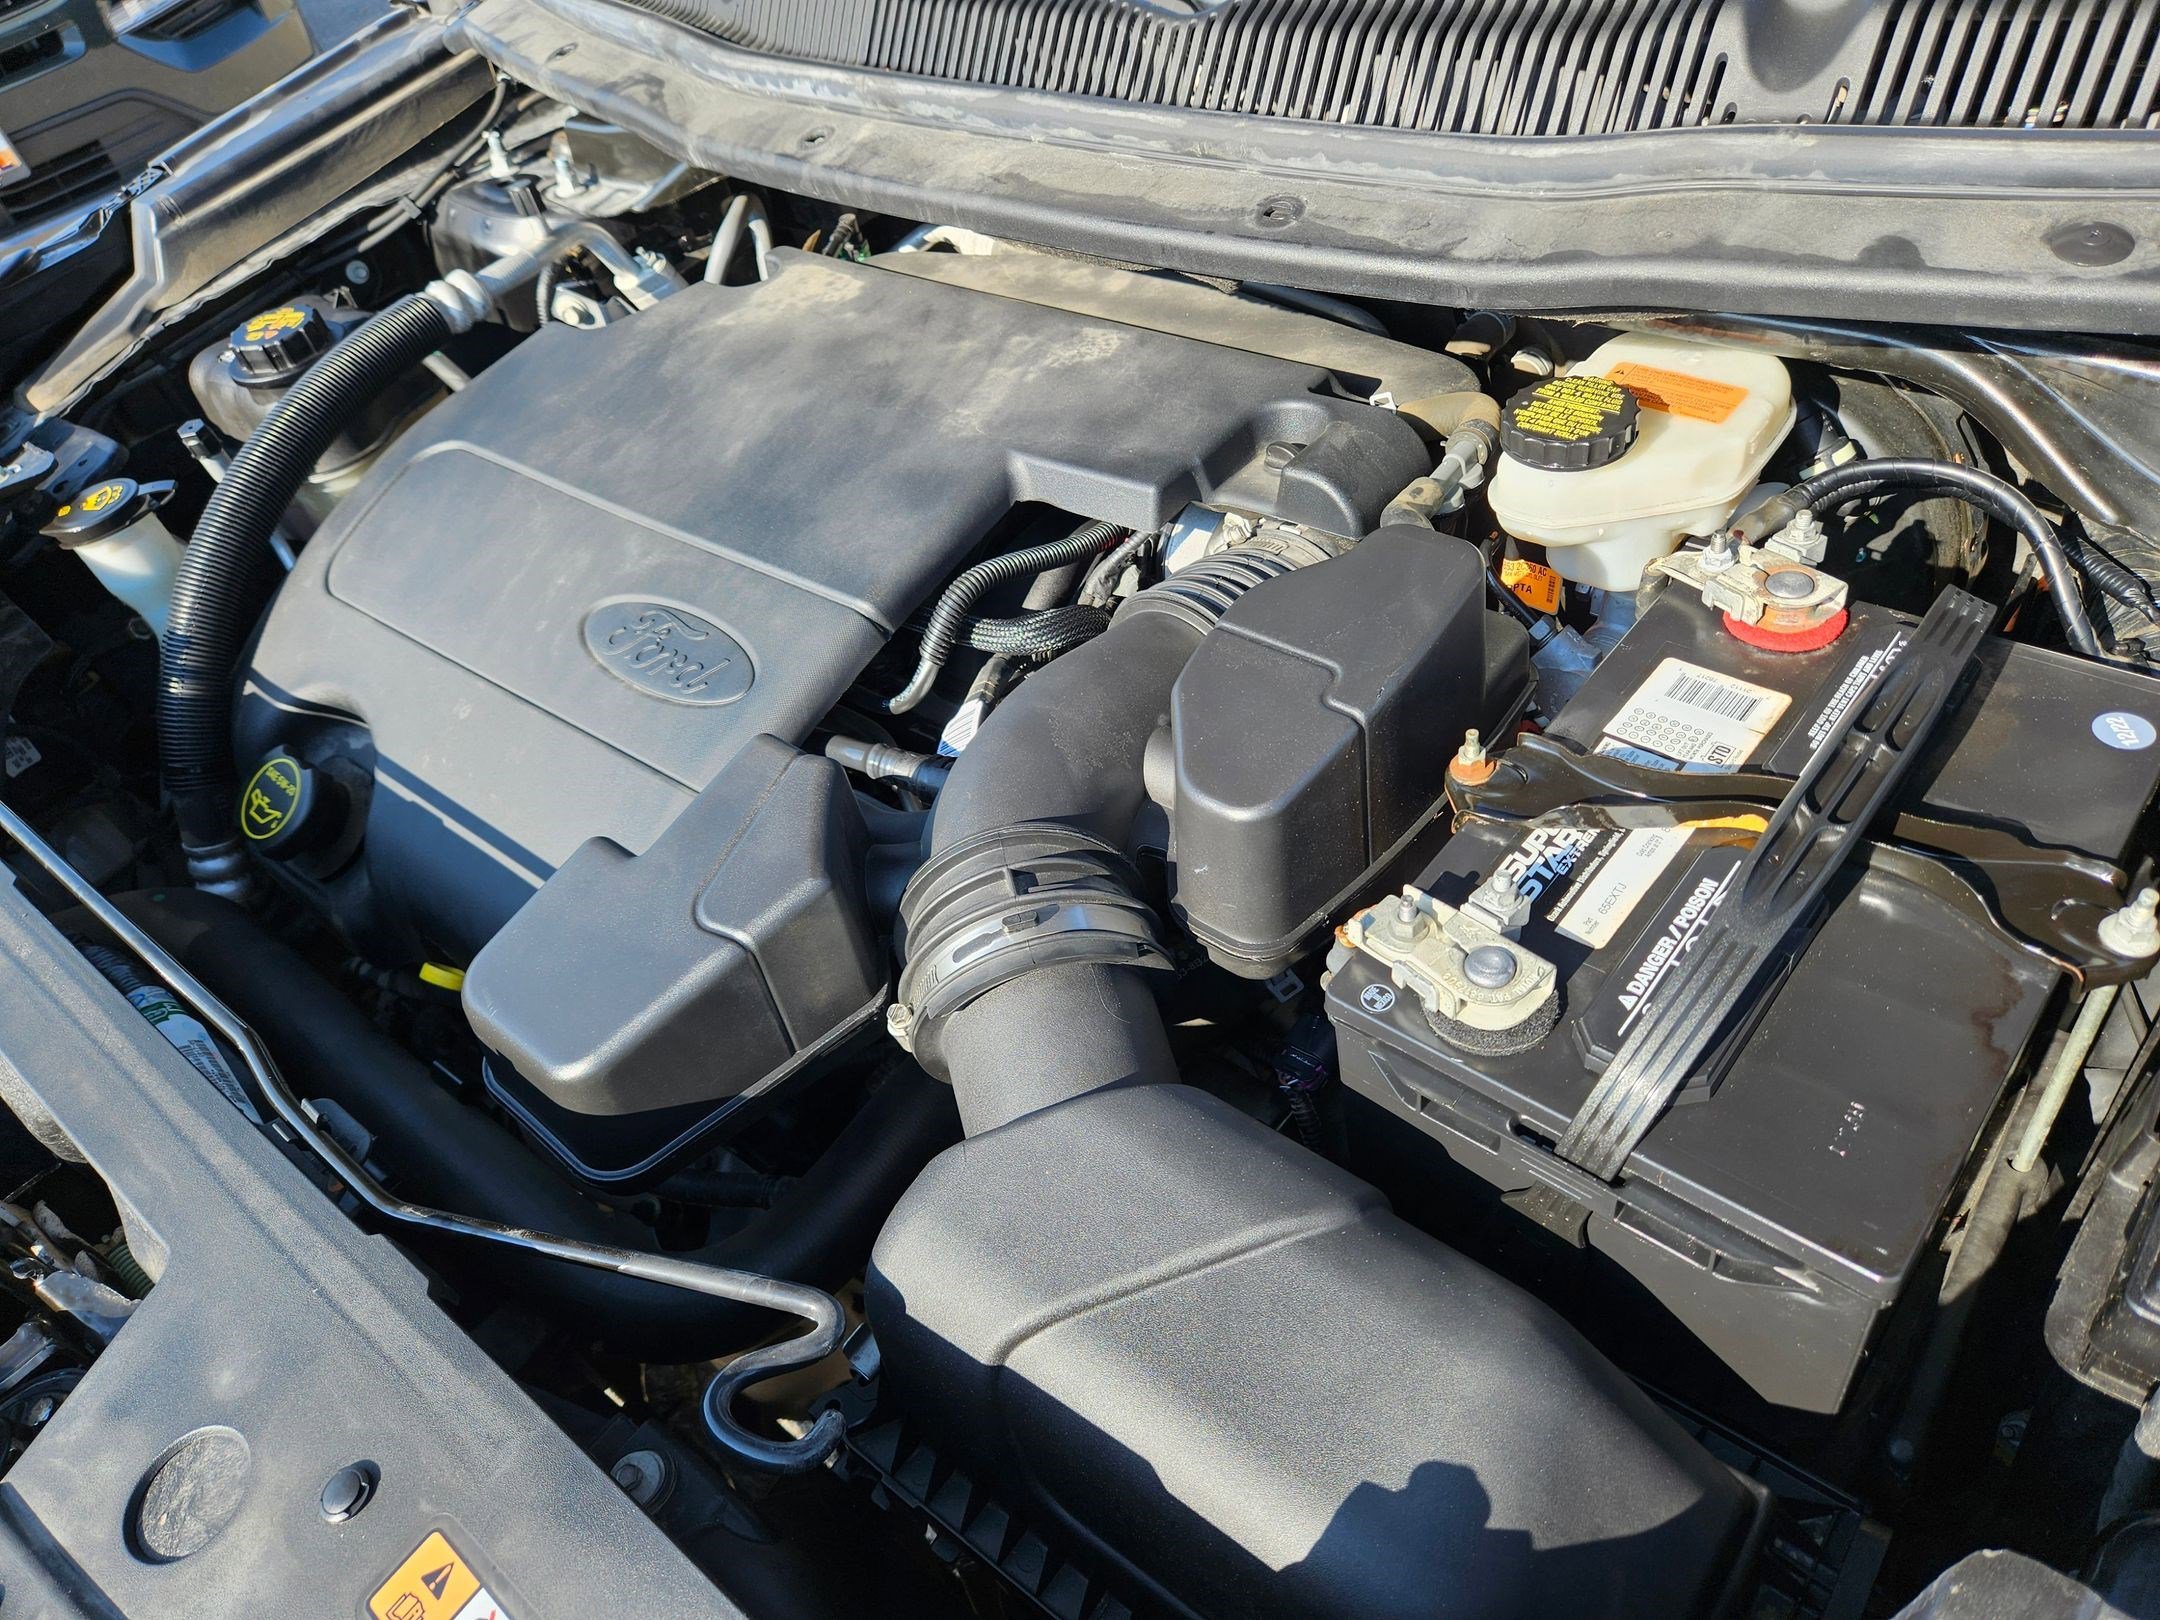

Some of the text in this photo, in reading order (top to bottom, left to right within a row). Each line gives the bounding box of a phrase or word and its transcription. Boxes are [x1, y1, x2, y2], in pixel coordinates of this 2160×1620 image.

[602, 607, 732, 695] Ford
[1707, 743, 1732, 765] STD
[1596, 881, 1628, 915] 65EXTJ
